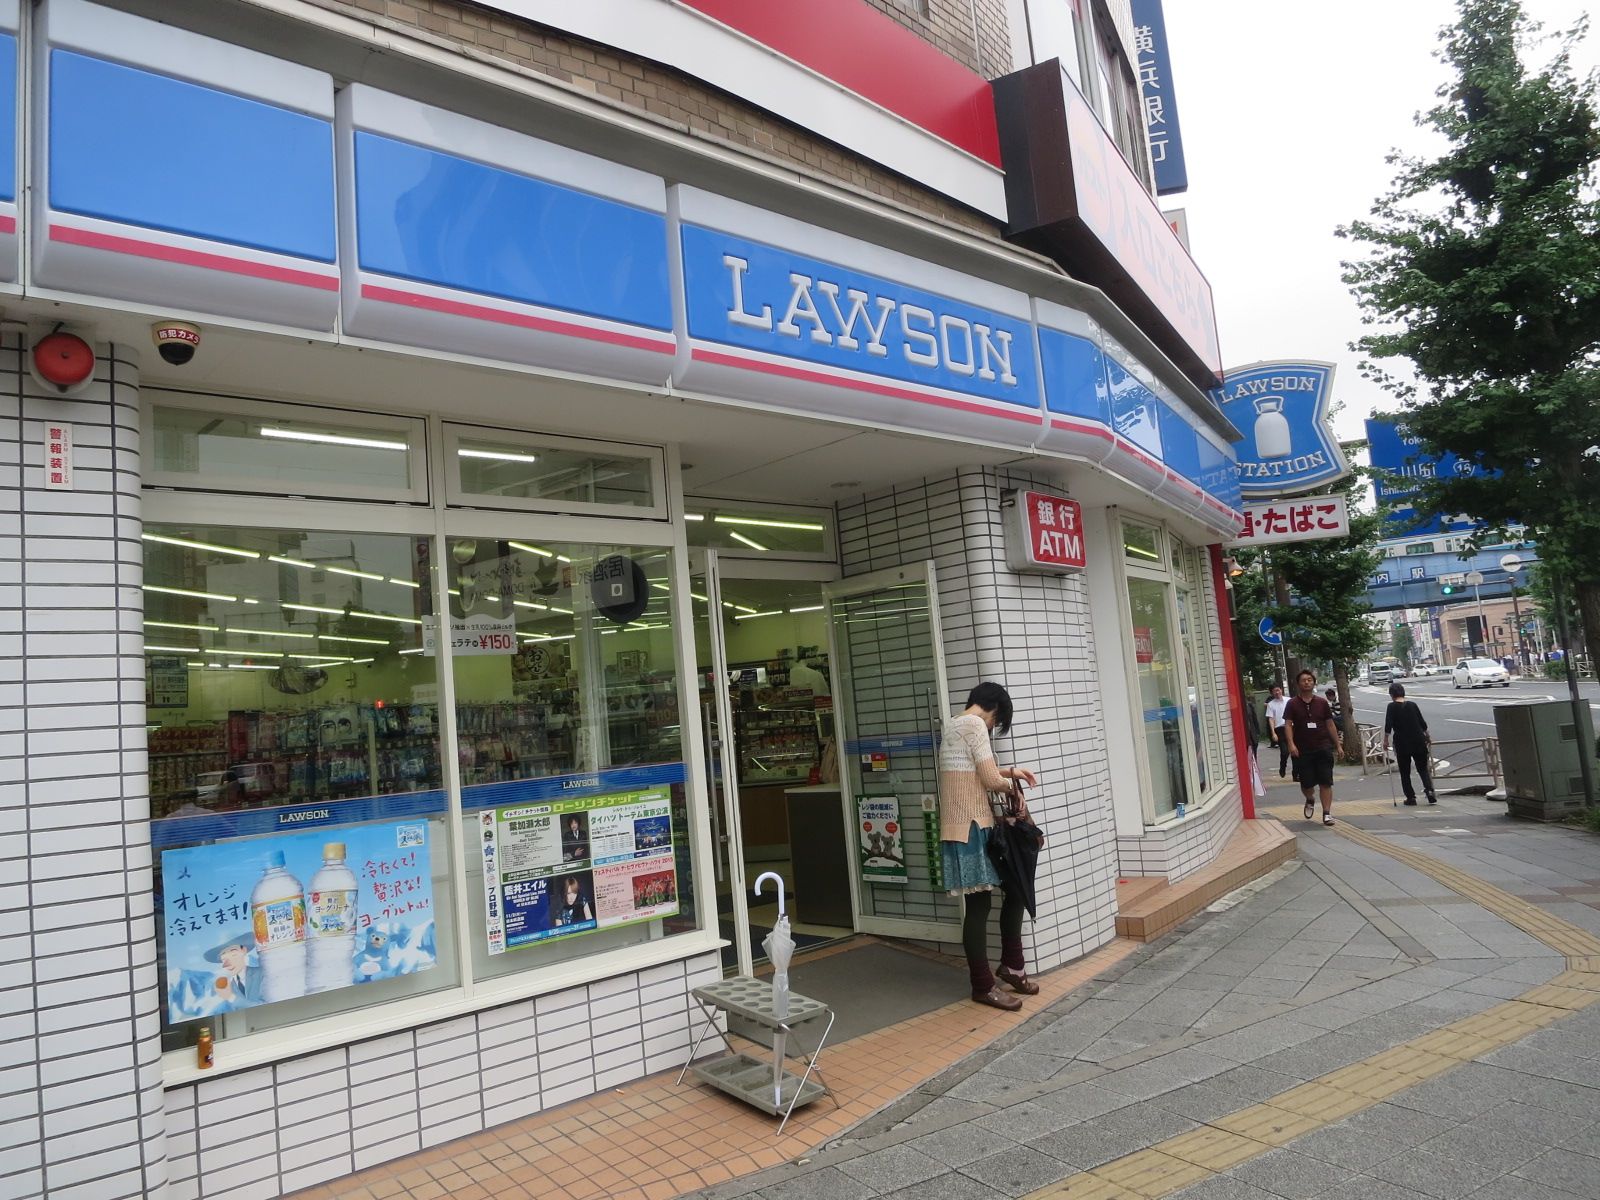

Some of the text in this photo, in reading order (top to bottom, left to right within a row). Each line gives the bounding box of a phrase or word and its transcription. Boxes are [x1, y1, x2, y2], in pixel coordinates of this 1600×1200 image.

[722, 254, 1019, 386] LAWSON
[158, 329, 200, 344] 防犯カメラ
[1217, 375, 1316, 404] LAWSON
[50, 428, 62, 484] 警報装置
[1237, 451, 1326, 479] STATION
[1037, 500, 1075, 529] 銀行
[1038, 530, 1082, 561] ATM
[1411, 568, 1425, 580] 駅
[479, 634, 511, 650] ¥150
[563, 778, 600, 790] LAWSON
[279, 809, 329, 823] LAWSON
[553, 794, 638, 813] ローソンチケット
[173, 883, 237, 912] オレンジ
[488, 887, 498, 917] プロ野球
[169, 901, 249, 936] 冷えてます!
